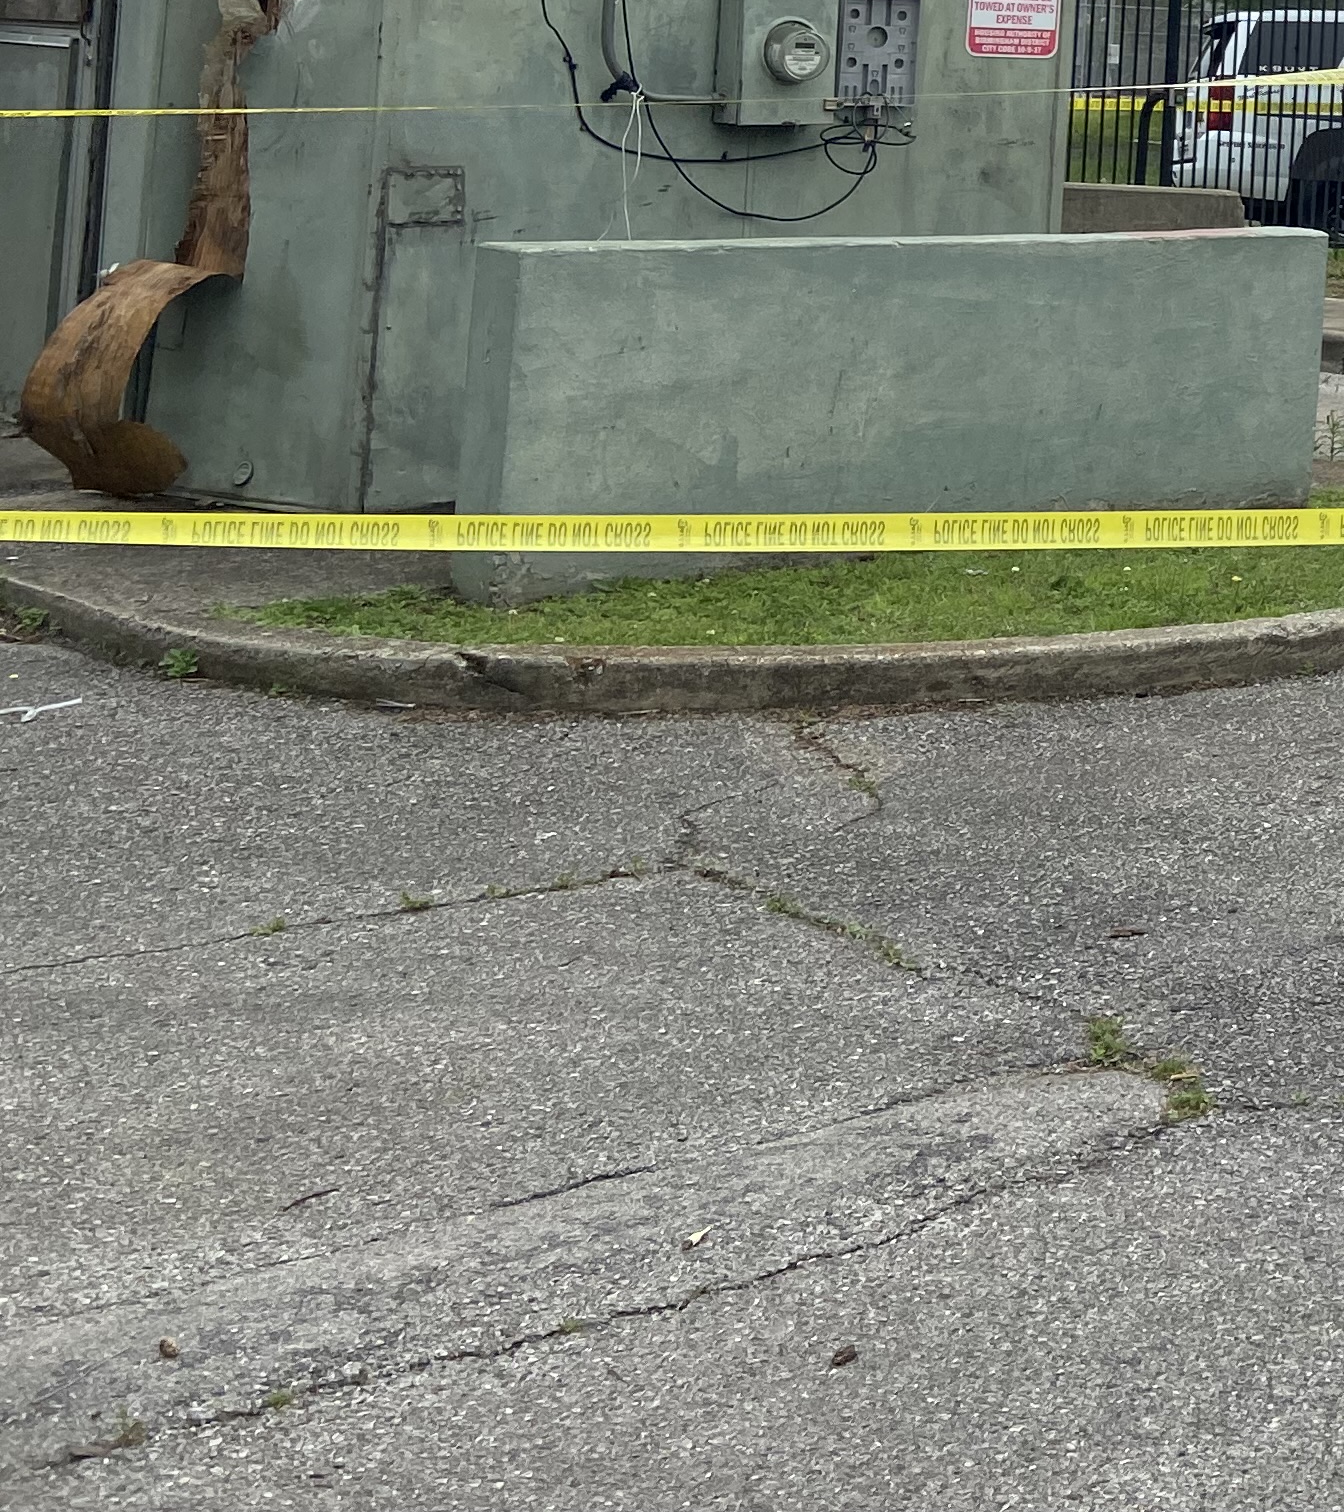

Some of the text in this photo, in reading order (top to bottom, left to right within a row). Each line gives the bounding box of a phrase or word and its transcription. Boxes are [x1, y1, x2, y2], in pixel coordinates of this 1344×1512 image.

[975, 1, 1054, 14] TOWED AT OWNER'S
[996, 14, 1032, 25] EXPENSE
